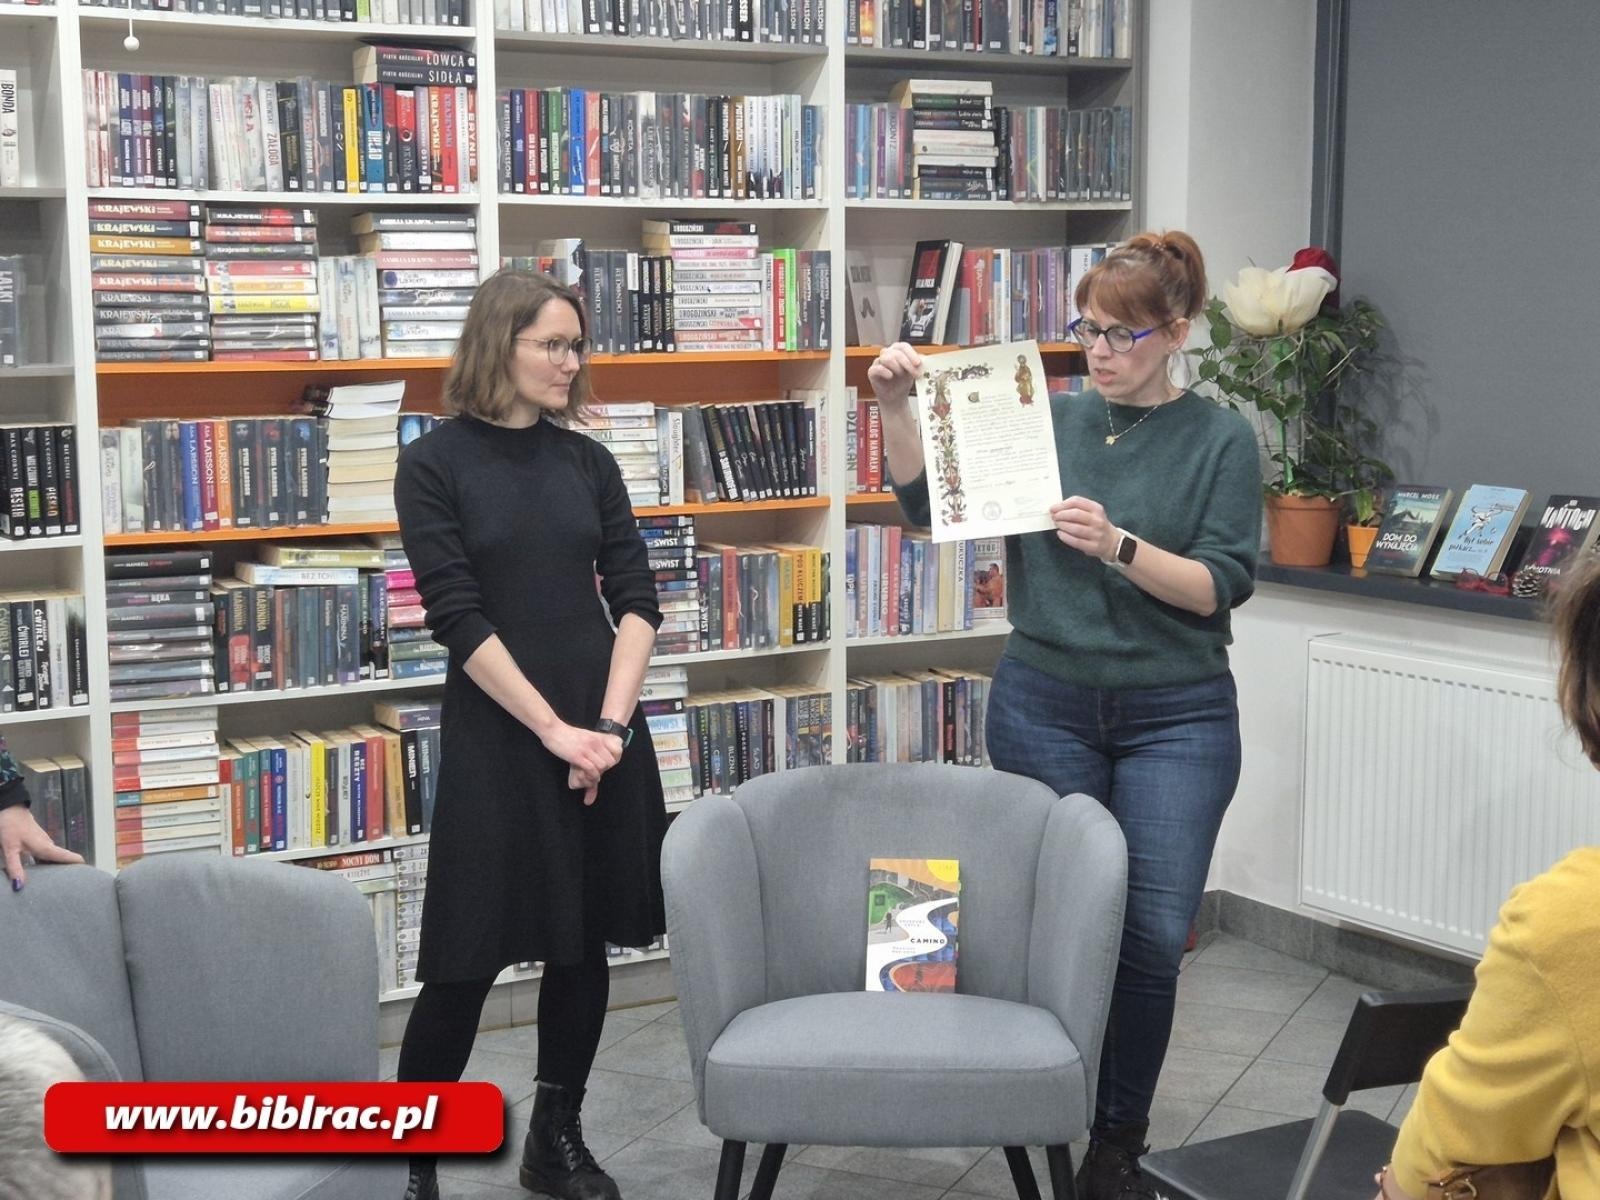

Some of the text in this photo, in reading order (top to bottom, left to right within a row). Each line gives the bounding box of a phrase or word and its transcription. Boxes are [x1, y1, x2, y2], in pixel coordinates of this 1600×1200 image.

[426, 53, 465, 68] ŁOWCA
[428, 70, 462, 83] SIDŁA
[1, 82, 15, 115] BONDA
[430, 93, 440, 149] KRAJEWSKI
[443, 92, 453, 148] KRAJEWSKI
[266, 132, 281, 167] ZAŁOGA
[468, 112, 476, 167] ERYNIE
[97, 204, 156, 215] KRAJEWSKI
[97, 223, 156, 234] KRAJEWSKI
[98, 239, 156, 250] KRAJEWSKI
[100, 259, 157, 269] KRAJEWSKI
[100, 277, 157, 287] KRAJEWSKI
[101, 294, 151, 303] KRAJEWSKI
[615, 267, 624, 314] REDONDO
[100, 309, 150, 319] KRAJEWSKI
[846, 410, 858, 472] DZIEKAN
[868, 405, 880, 473] DEKALOG NAWAŁKI
[10, 449, 19, 480] CZORNYJ
[188, 439, 198, 484] LARSSON
[203, 439, 214, 484] LARSSON
[218, 438, 229, 484] LARSSON
[242, 467, 251, 496] LARSSON
[270, 467, 279, 497] LARSSON
[301, 467, 309, 498] LARSSON
[10, 487, 26, 518] BESTIA
[1382, 532, 1418, 543] DOM DO
[957, 542, 965, 582] UKUCZKA
[881, 573, 889, 615] URUBKO
[233, 590, 243, 632] MARININA
[256, 590, 267, 632] MARININA
[17, 625, 30, 658] ĆWIRLEJ
[34, 607, 45, 652] ĆWIRLEJ
[407, 745, 418, 779] MINIER
[728, 745, 736, 776] BLIZNA
[910, 937, 946, 945] CAMINO
